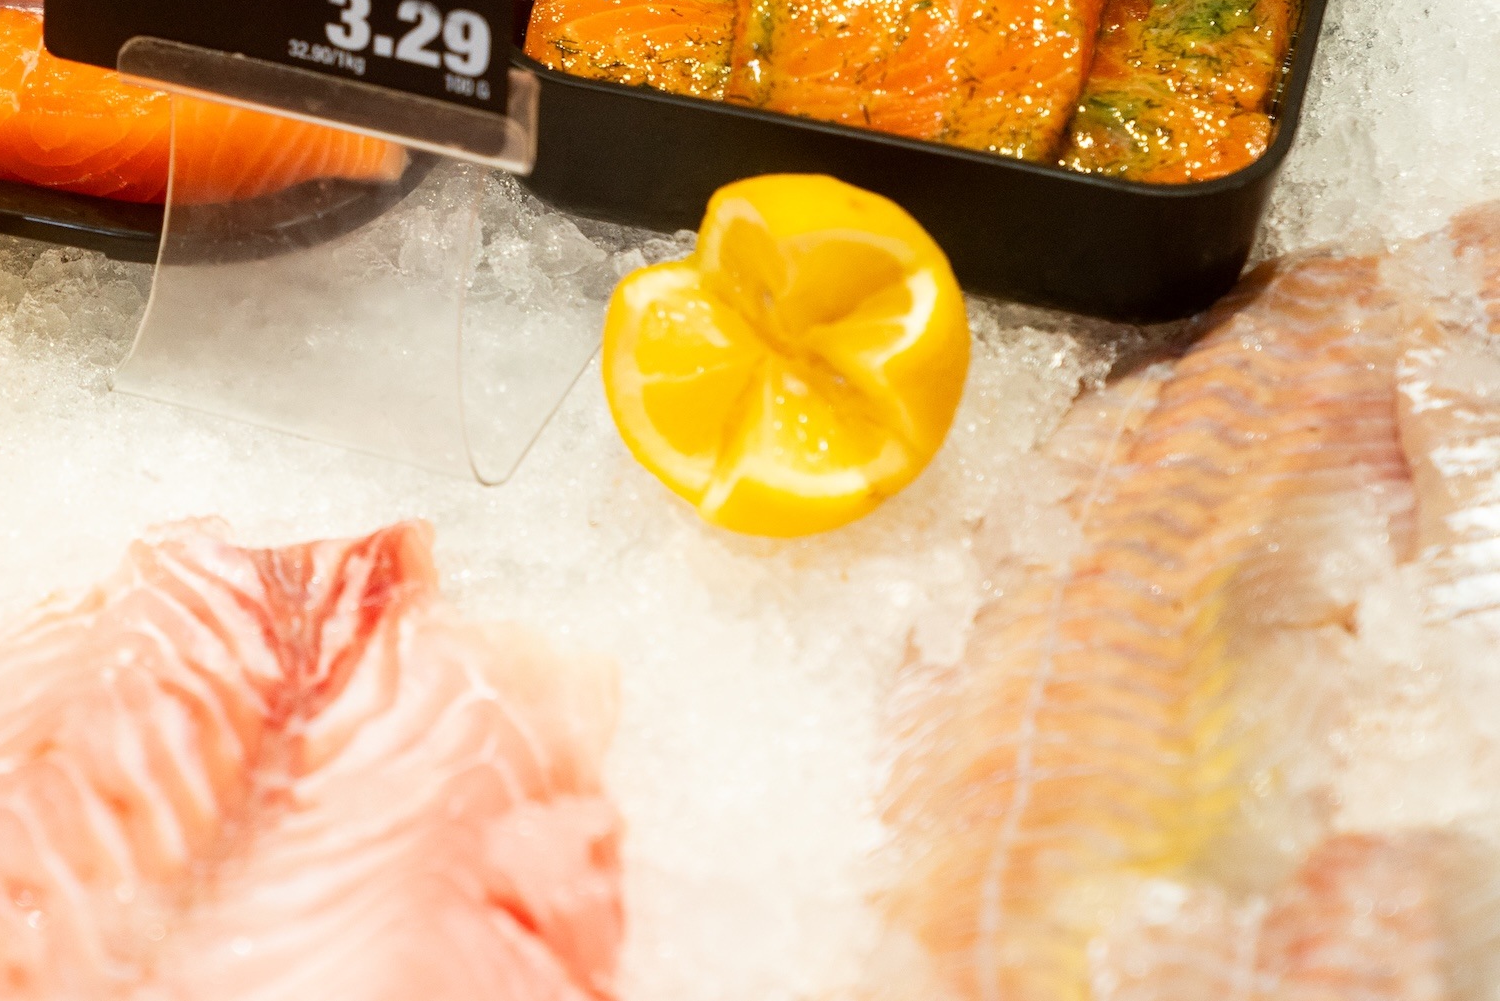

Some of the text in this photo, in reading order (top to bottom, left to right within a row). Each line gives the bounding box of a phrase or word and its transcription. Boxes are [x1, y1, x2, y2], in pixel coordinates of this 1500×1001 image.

[288, 38, 367, 77] 32.90/1kg
[445, 72, 491, 101] 100 G
